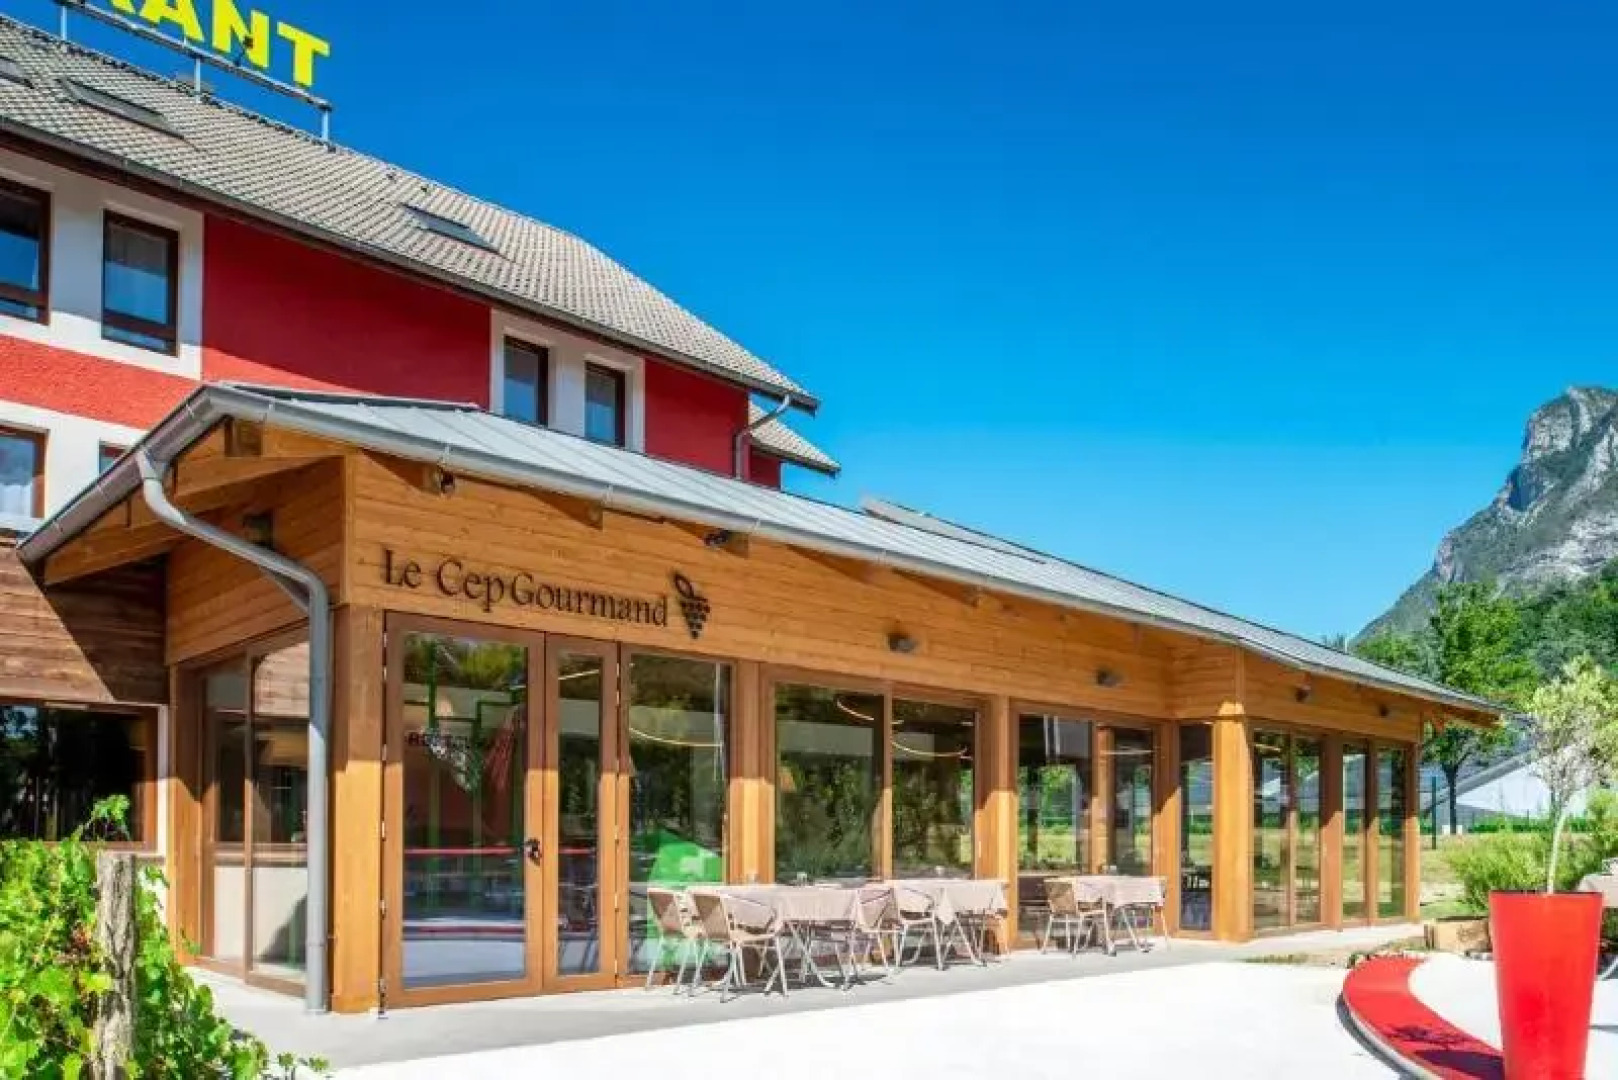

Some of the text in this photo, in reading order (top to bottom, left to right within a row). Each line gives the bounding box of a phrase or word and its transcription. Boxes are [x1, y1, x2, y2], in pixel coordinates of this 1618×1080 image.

[110, 0, 330, 87] ANT
[382, 548, 668, 627] Le Cep Gourmand
